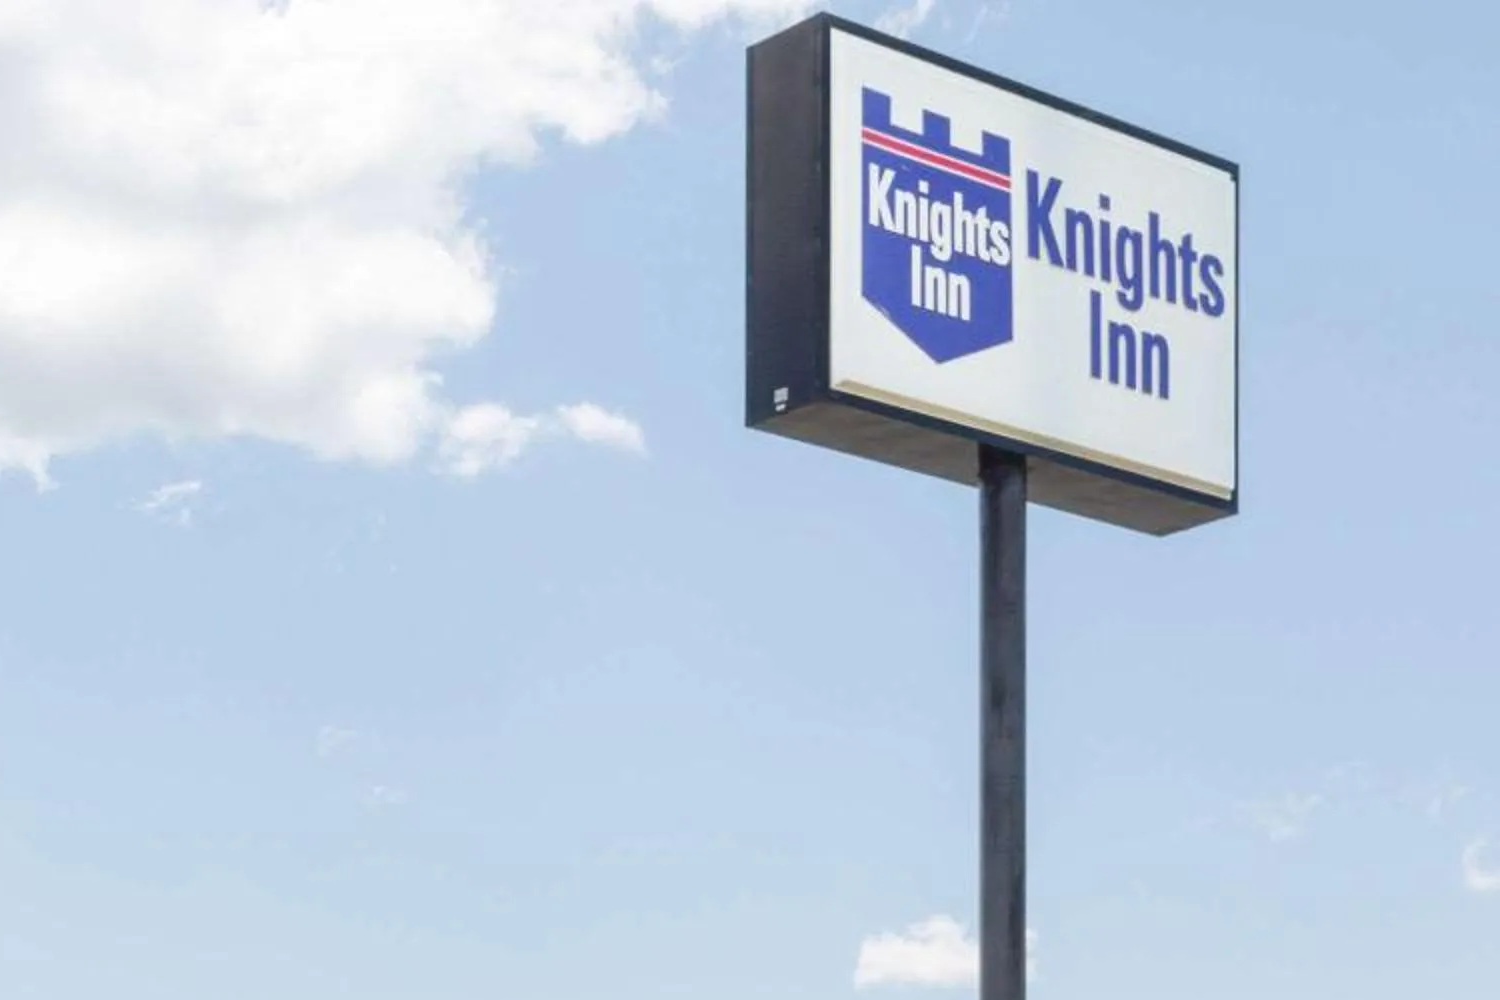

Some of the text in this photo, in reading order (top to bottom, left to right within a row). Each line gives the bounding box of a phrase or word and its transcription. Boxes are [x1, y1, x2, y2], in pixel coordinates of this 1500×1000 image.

[868, 163, 1011, 266] Knights
[1026, 169, 1225, 317] Knights
[911, 245, 971, 321] Inn
[1090, 291, 1170, 400] Inn
